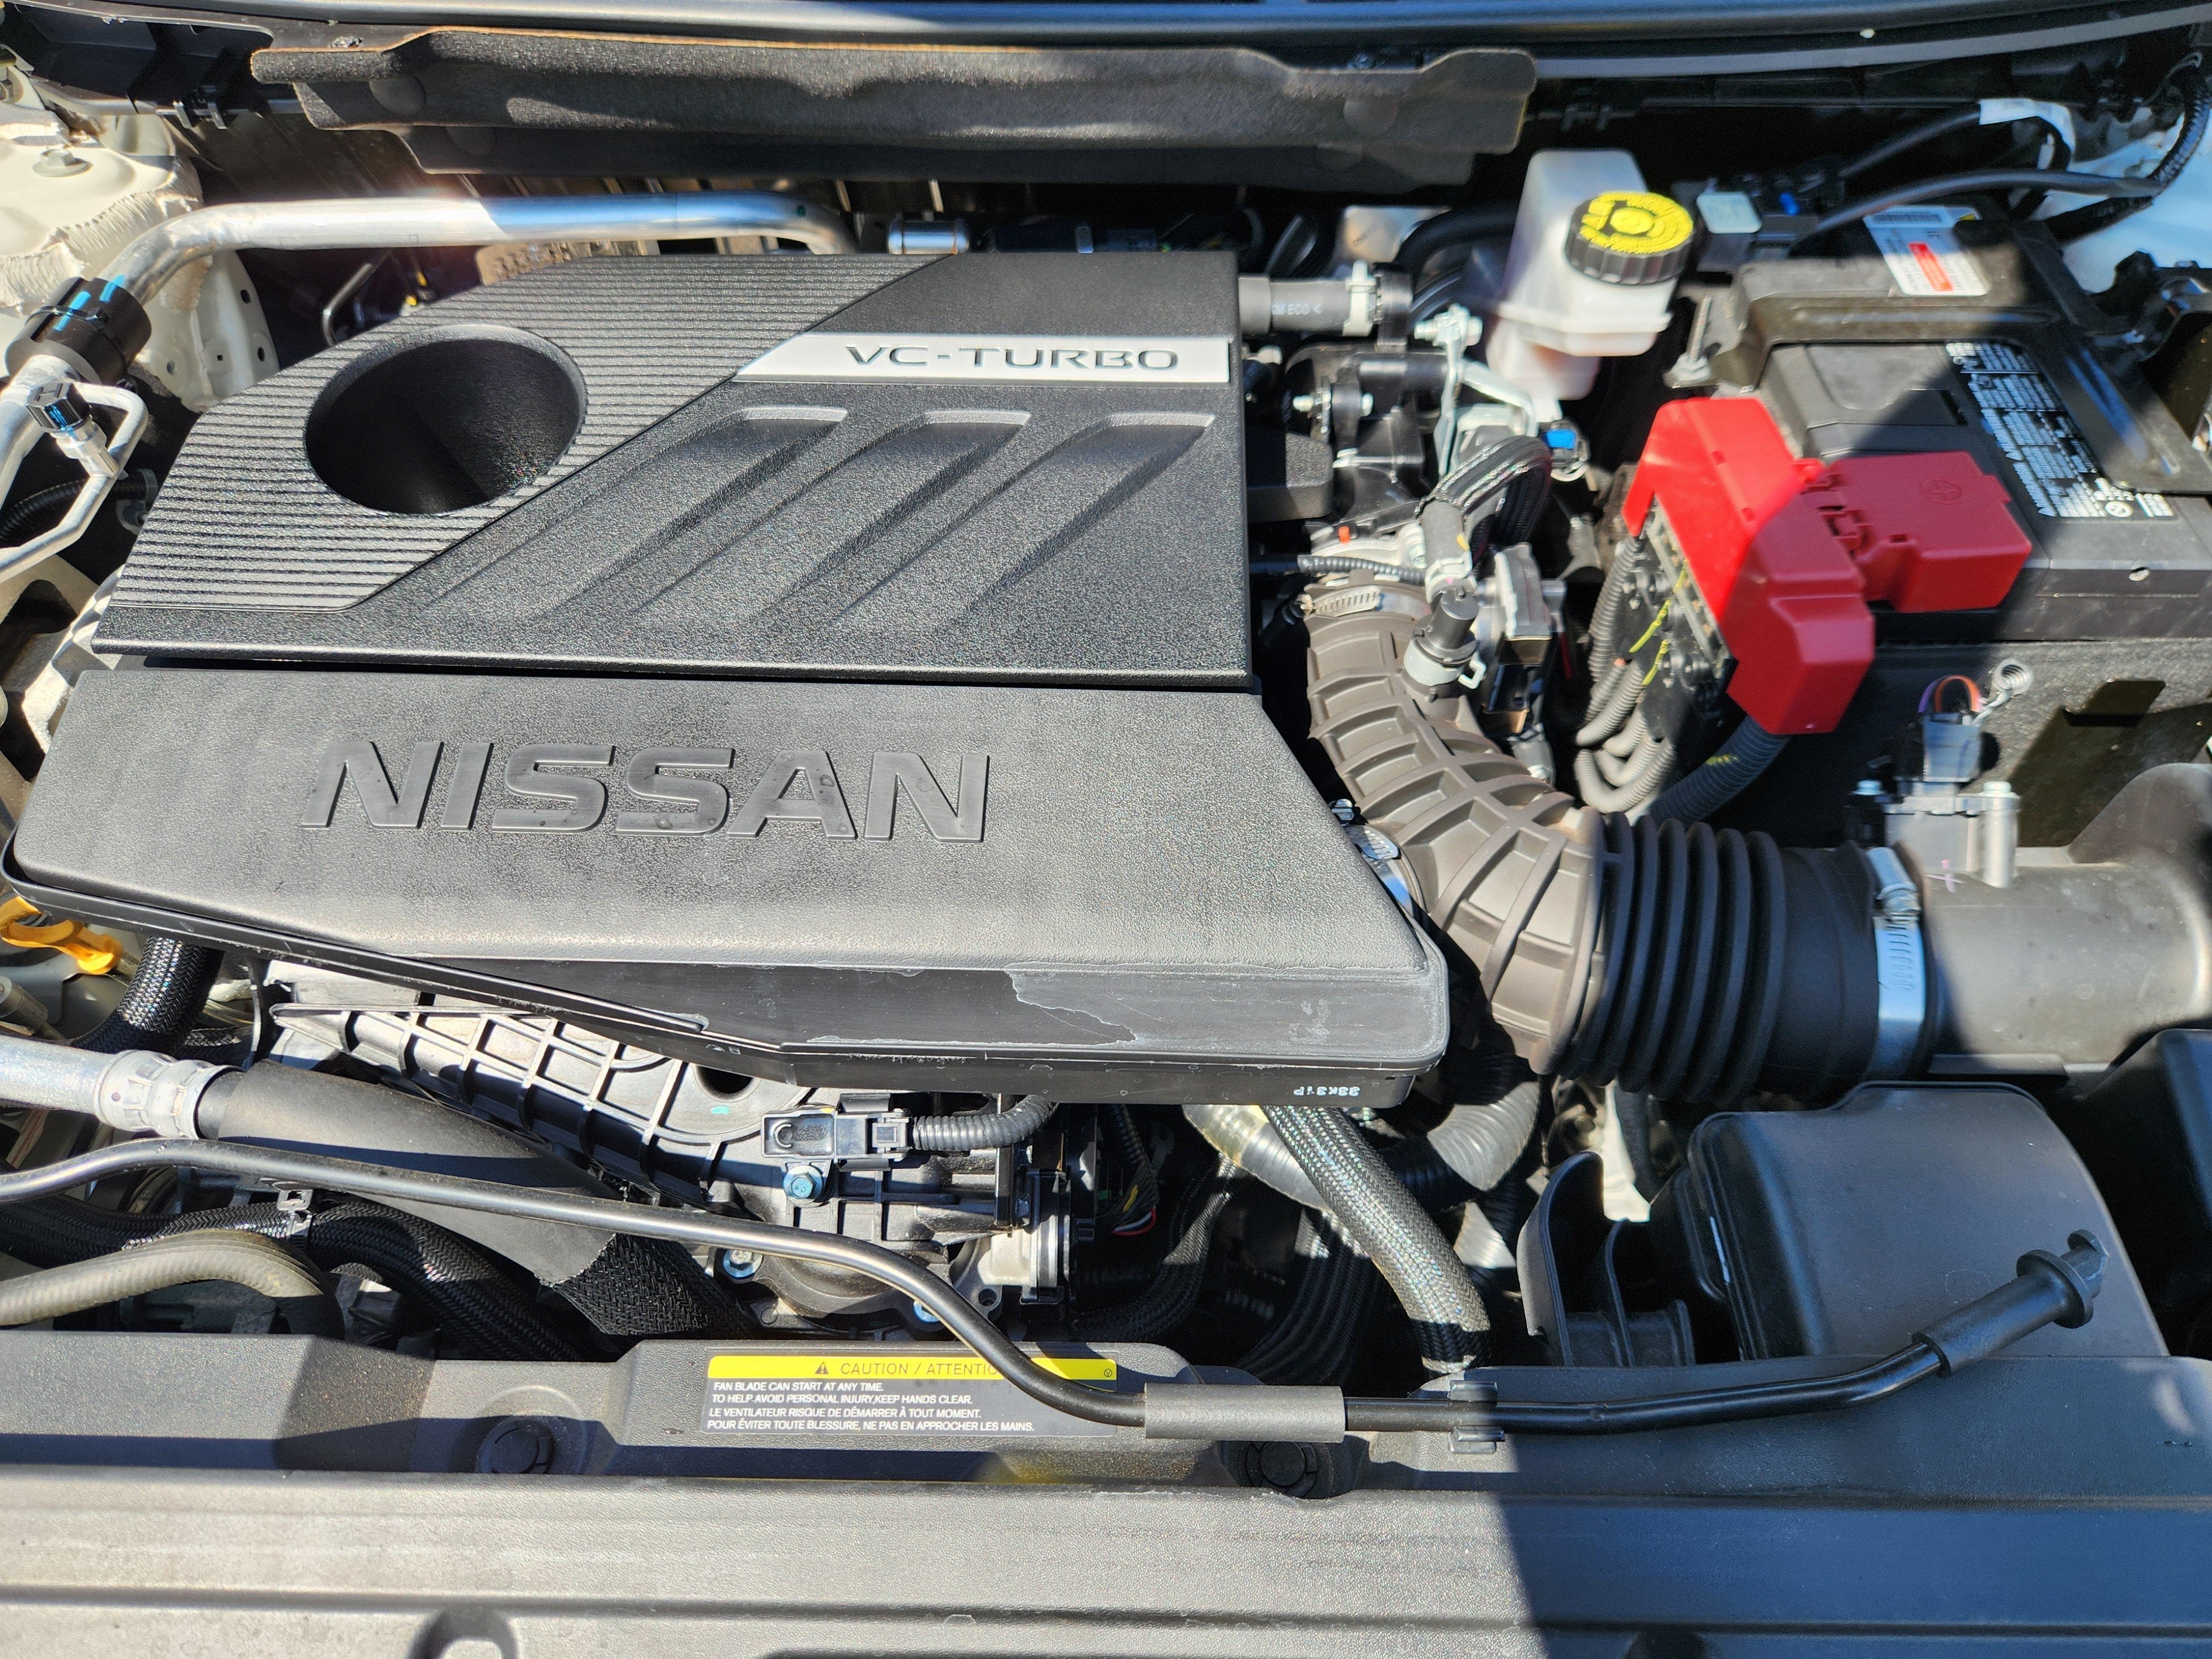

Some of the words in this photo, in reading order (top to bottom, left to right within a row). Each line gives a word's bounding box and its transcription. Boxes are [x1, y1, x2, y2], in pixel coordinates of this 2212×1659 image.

[845, 345, 1180, 371] VC-TURBO
[300, 740, 990, 844] NISSAN
[841, 1363, 909, 1375] CAUTION
[914, 1363, 922, 1374] /
[926, 1363, 998, 1375] ATTENTIO
[713, 1382, 733, 1391] FAN
[734, 1382, 766, 1391] BLADE
[768, 1382, 790, 1391] CAN
[791, 1382, 822, 1391] START
[823, 1383, 836, 1391] AT
[837, 1383, 858, 1391] ANY
[860, 1383, 884, 1391] TIME.
[712, 1394, 726, 1403] TO
[754, 1394, 785, 1404] AVOID
[786, 1394, 839, 1404] PERSONAL
[901, 1395, 936, 1404] HANDS
[938, 1395, 973, 1404] CLEAR.
[708, 1408, 722, 1417] LE
[723, 1408, 786, 1417] VENTILATEUR
[787, 1408, 826, 1417] RISQUE
[827, 1408, 843, 1417] DE
[843, 1406, 898, 1418] DÉMARRER
[899, 1406, 907, 1418] À
[909, 1408, 935, 1418] TOUT
[936, 1408, 982, 1418] MOMENT.
[707, 1420, 737, 1430] POUR
[737, 1417, 772, 1430] ÉVITER
[773, 1420, 806, 1430] TOUTE
[806, 1421, 860, 1431] BLESSURE,
[863, 1421, 878, 1430] NE
[879, 1421, 899, 1430] PAS
[900, 1421, 915, 1430] EN
[916, 1421, 979, 1431] APPROCHER
[980, 1422, 999, 1431] LES
[1000, 1422, 1034, 1431] MAINS.
